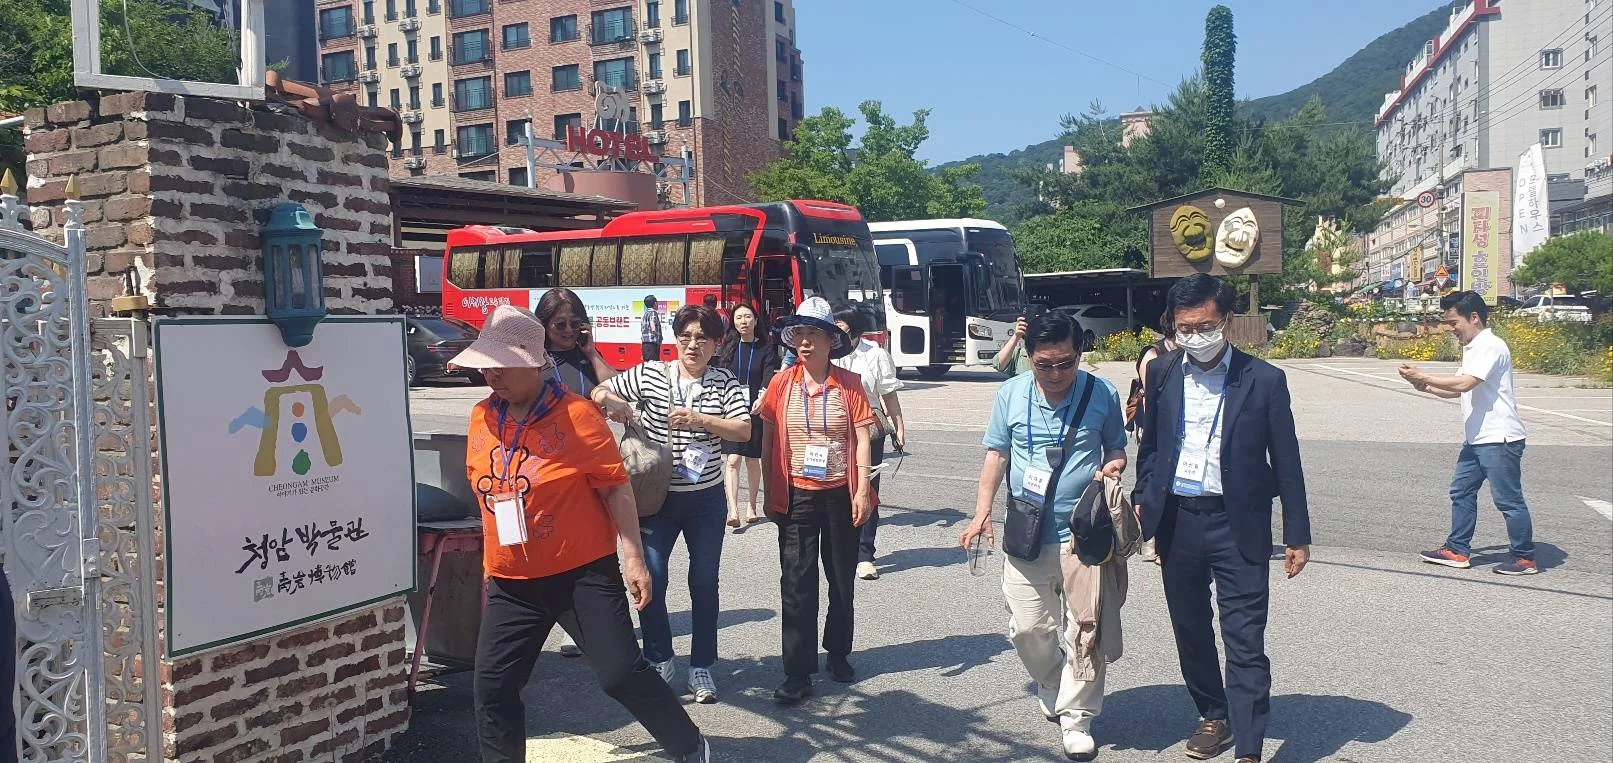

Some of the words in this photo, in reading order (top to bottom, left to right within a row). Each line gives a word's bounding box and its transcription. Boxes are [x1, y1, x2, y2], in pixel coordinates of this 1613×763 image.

[566, 124, 659, 163] HOTEL
[1421, 195, 1432, 204] 30
[1519, 178, 1529, 233] OPEN
[813, 232, 857, 247] Limousine
[595, 316, 630, 328] 공동브랜드
[268, 480, 308, 492] CHEONGAM
[311, 475, 339, 484] MUSEUM
[235, 527, 294, 574] 청암
[295, 517, 369, 556] 박물관
